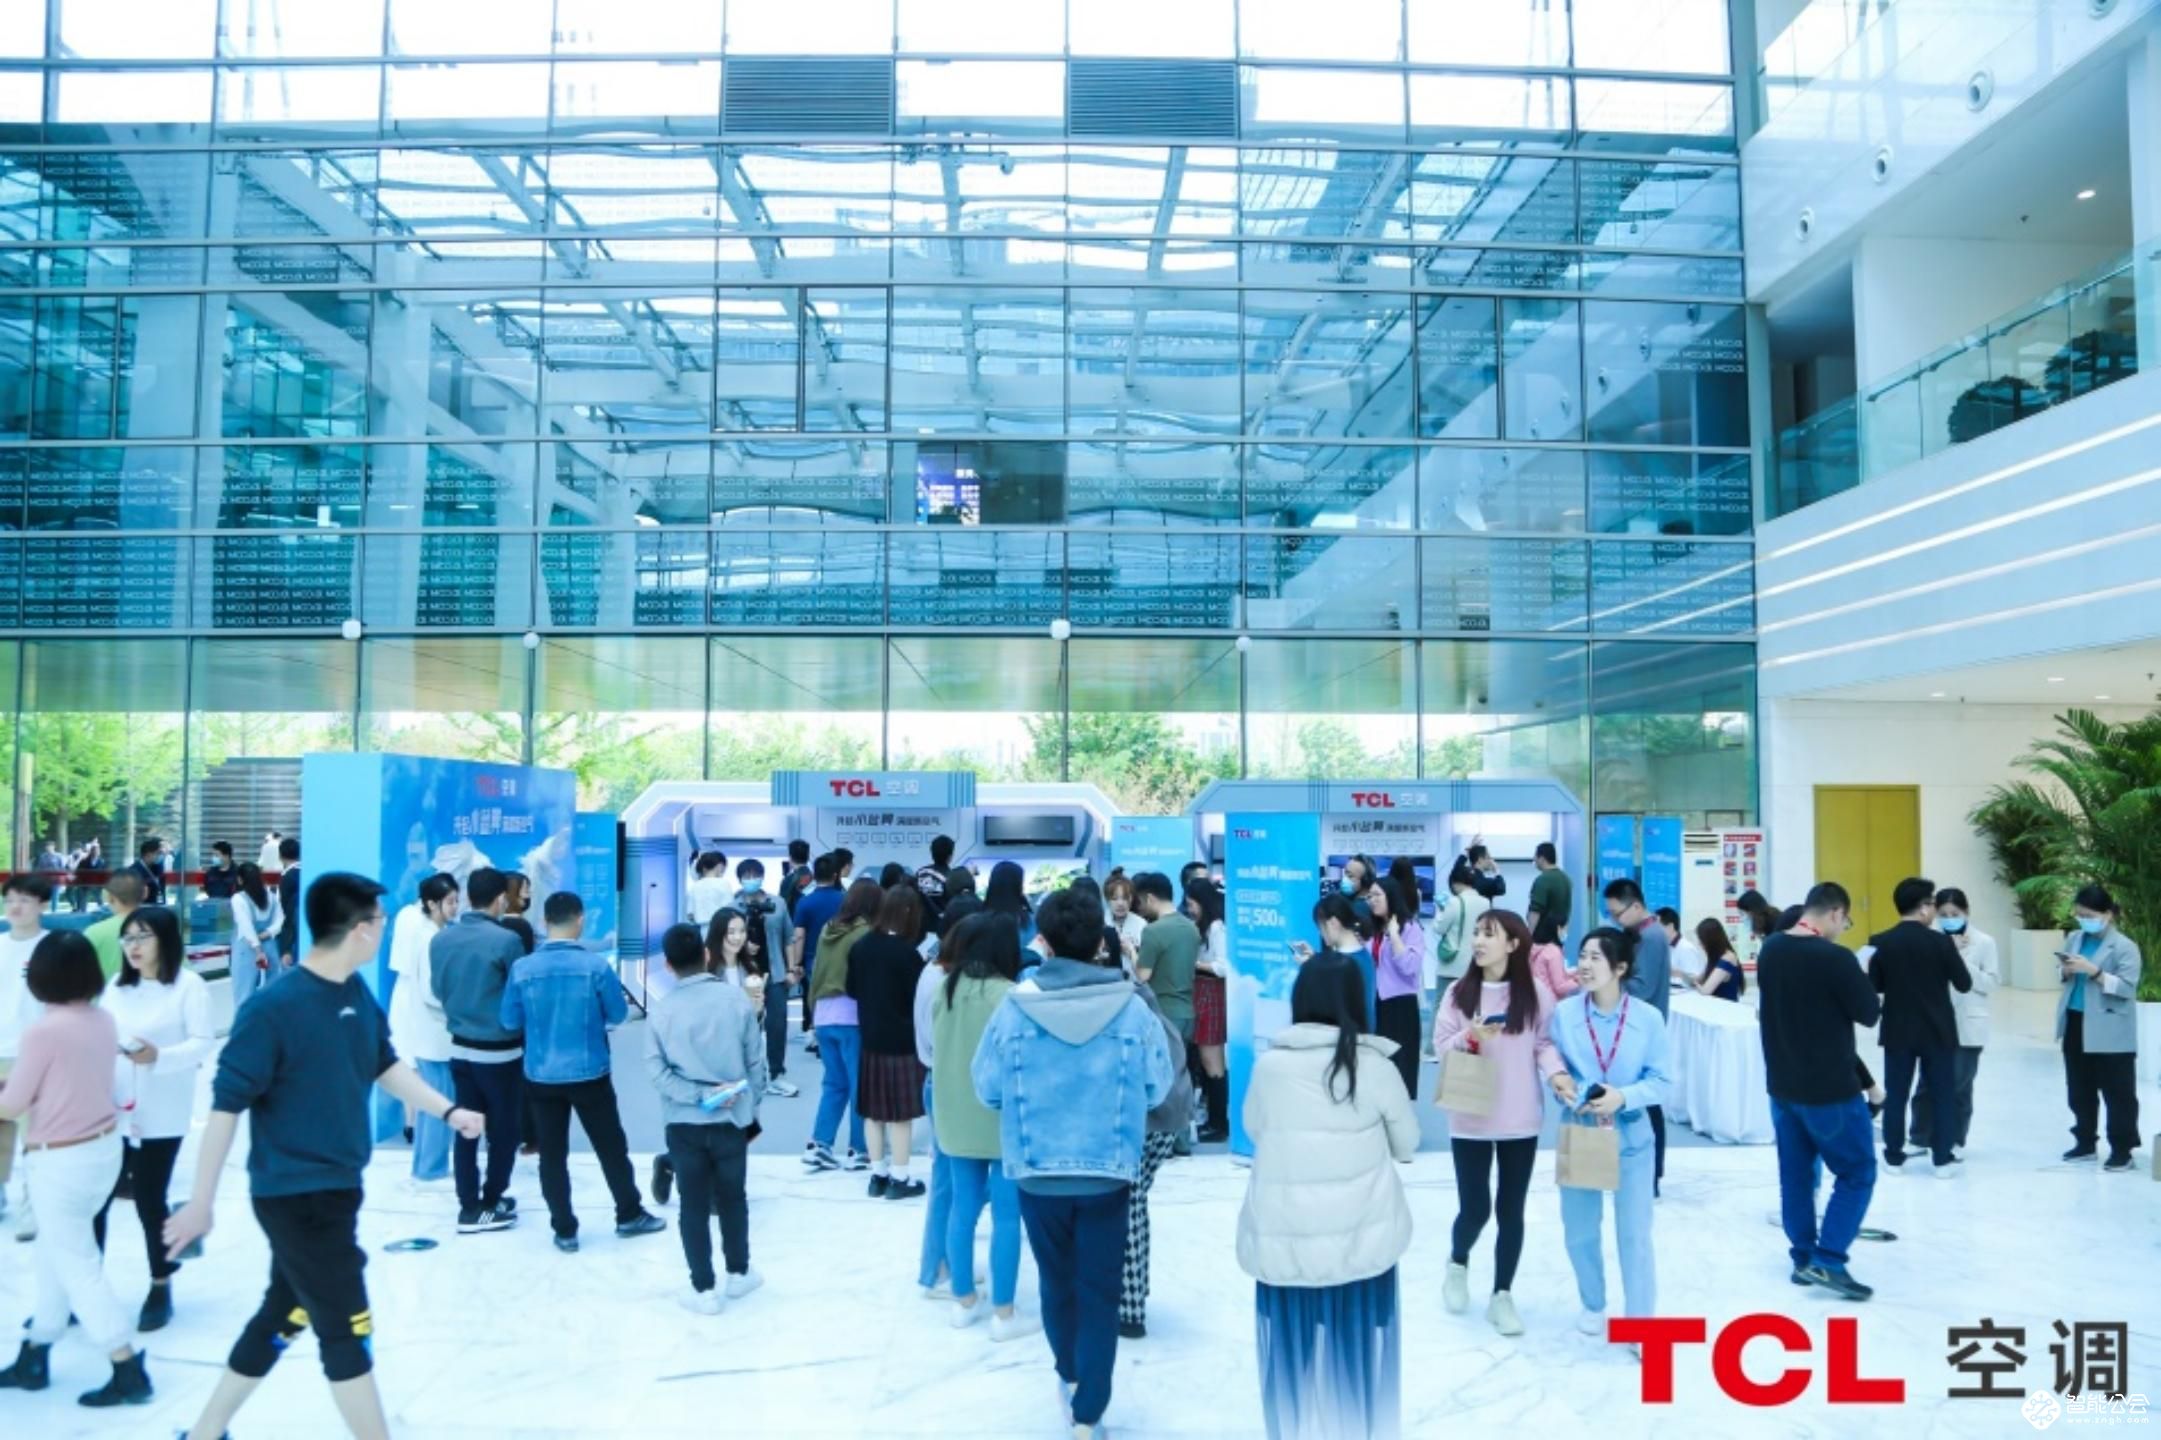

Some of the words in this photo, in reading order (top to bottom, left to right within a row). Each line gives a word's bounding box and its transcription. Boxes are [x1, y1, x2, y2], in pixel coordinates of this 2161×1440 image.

[830, 780, 880, 797] TCL
[1351, 792, 1396, 808] TCL
[1253, 908, 1278, 926] 500
